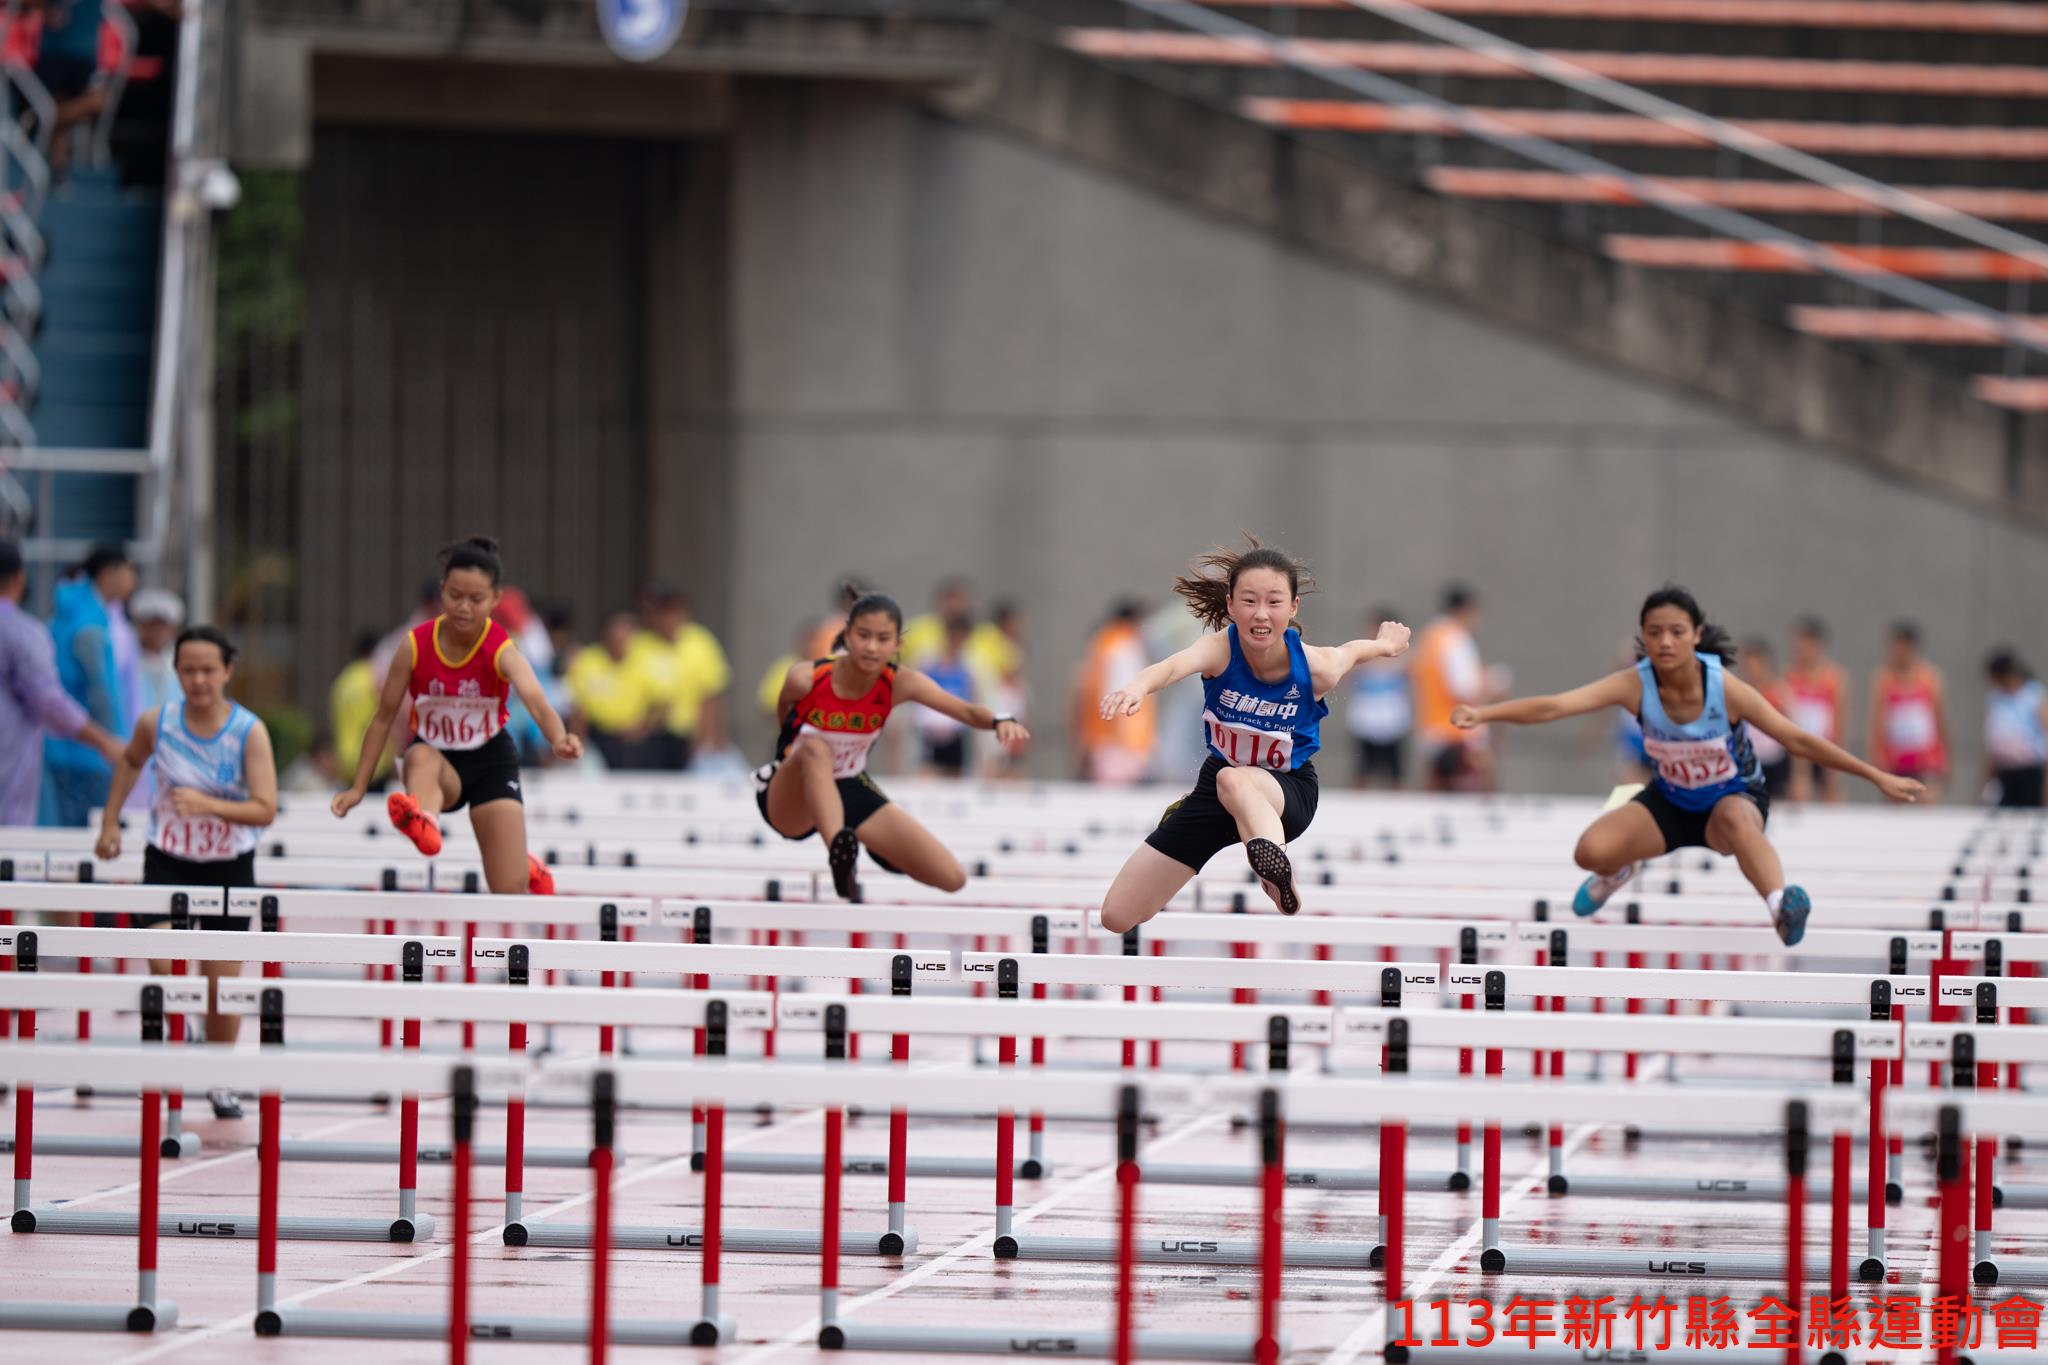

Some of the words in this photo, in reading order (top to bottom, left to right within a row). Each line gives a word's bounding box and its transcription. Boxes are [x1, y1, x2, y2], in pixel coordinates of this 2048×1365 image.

[1219, 688, 1299, 720] 芎林國中
[425, 709, 493, 745] 6064
[1214, 723, 1285, 769] 6116
[162, 819, 231, 856] 6132
[425, 949, 457, 957] UCS
[474, 950, 506, 958] UCS
[915, 963, 946, 971] UCS
[963, 964, 995, 972] UCS
[1404, 976, 1436, 984] UCS
[1450, 976, 1482, 985] UCS
[1894, 988, 1926, 996] UCS
[1941, 988, 1973, 996] UCS
[1287, 1174, 1317, 1184] CS
[1696, 1181, 1747, 1192] UCS
[177, 1222, 236, 1236] UCS
[667, 1235, 704, 1247] UC
[1160, 1241, 1219, 1253] UCS
[1648, 1261, 1706, 1274] UCS
[470, 1325, 512, 1338] CS
[1010, 1339, 1077, 1352] UCS
